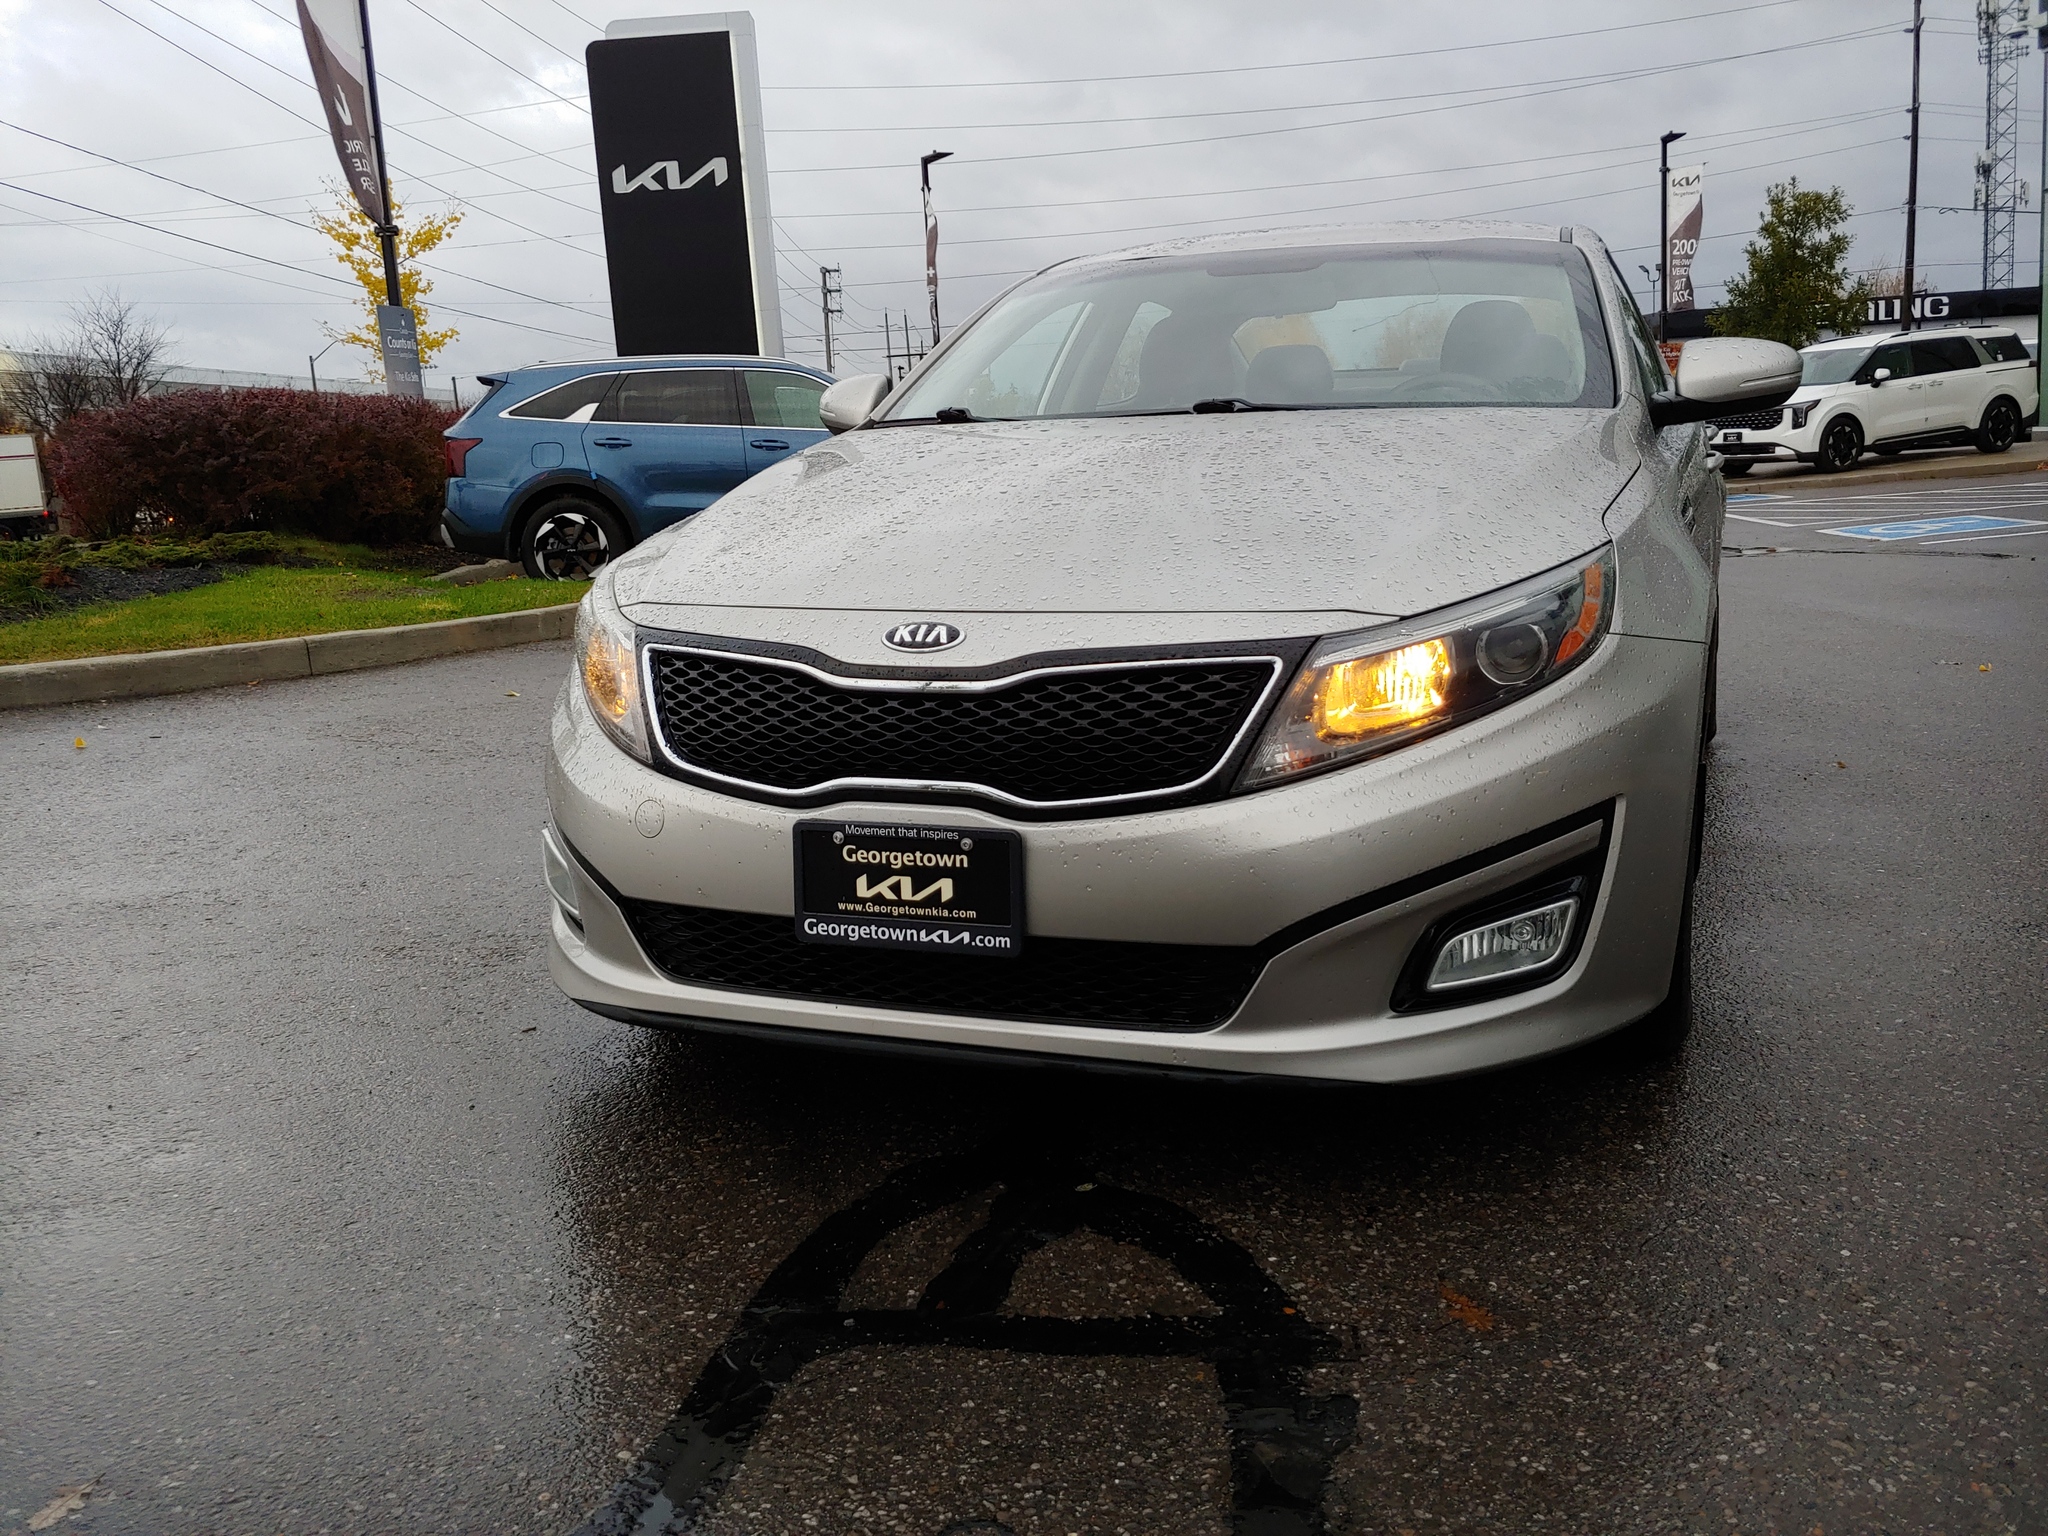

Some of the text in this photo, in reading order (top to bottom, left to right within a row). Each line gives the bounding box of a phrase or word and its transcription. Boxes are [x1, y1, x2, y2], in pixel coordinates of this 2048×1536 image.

[612, 157, 728, 193] KIA
[1672, 174, 1700, 187] KIA
[893, 624, 947, 643] KIA
[845, 825, 959, 840] Movement that inspires
[842, 845, 968, 868] Georgetown
[856, 874, 953, 903] KIA
[838, 901, 977, 919] www.Georgetownkia.com
